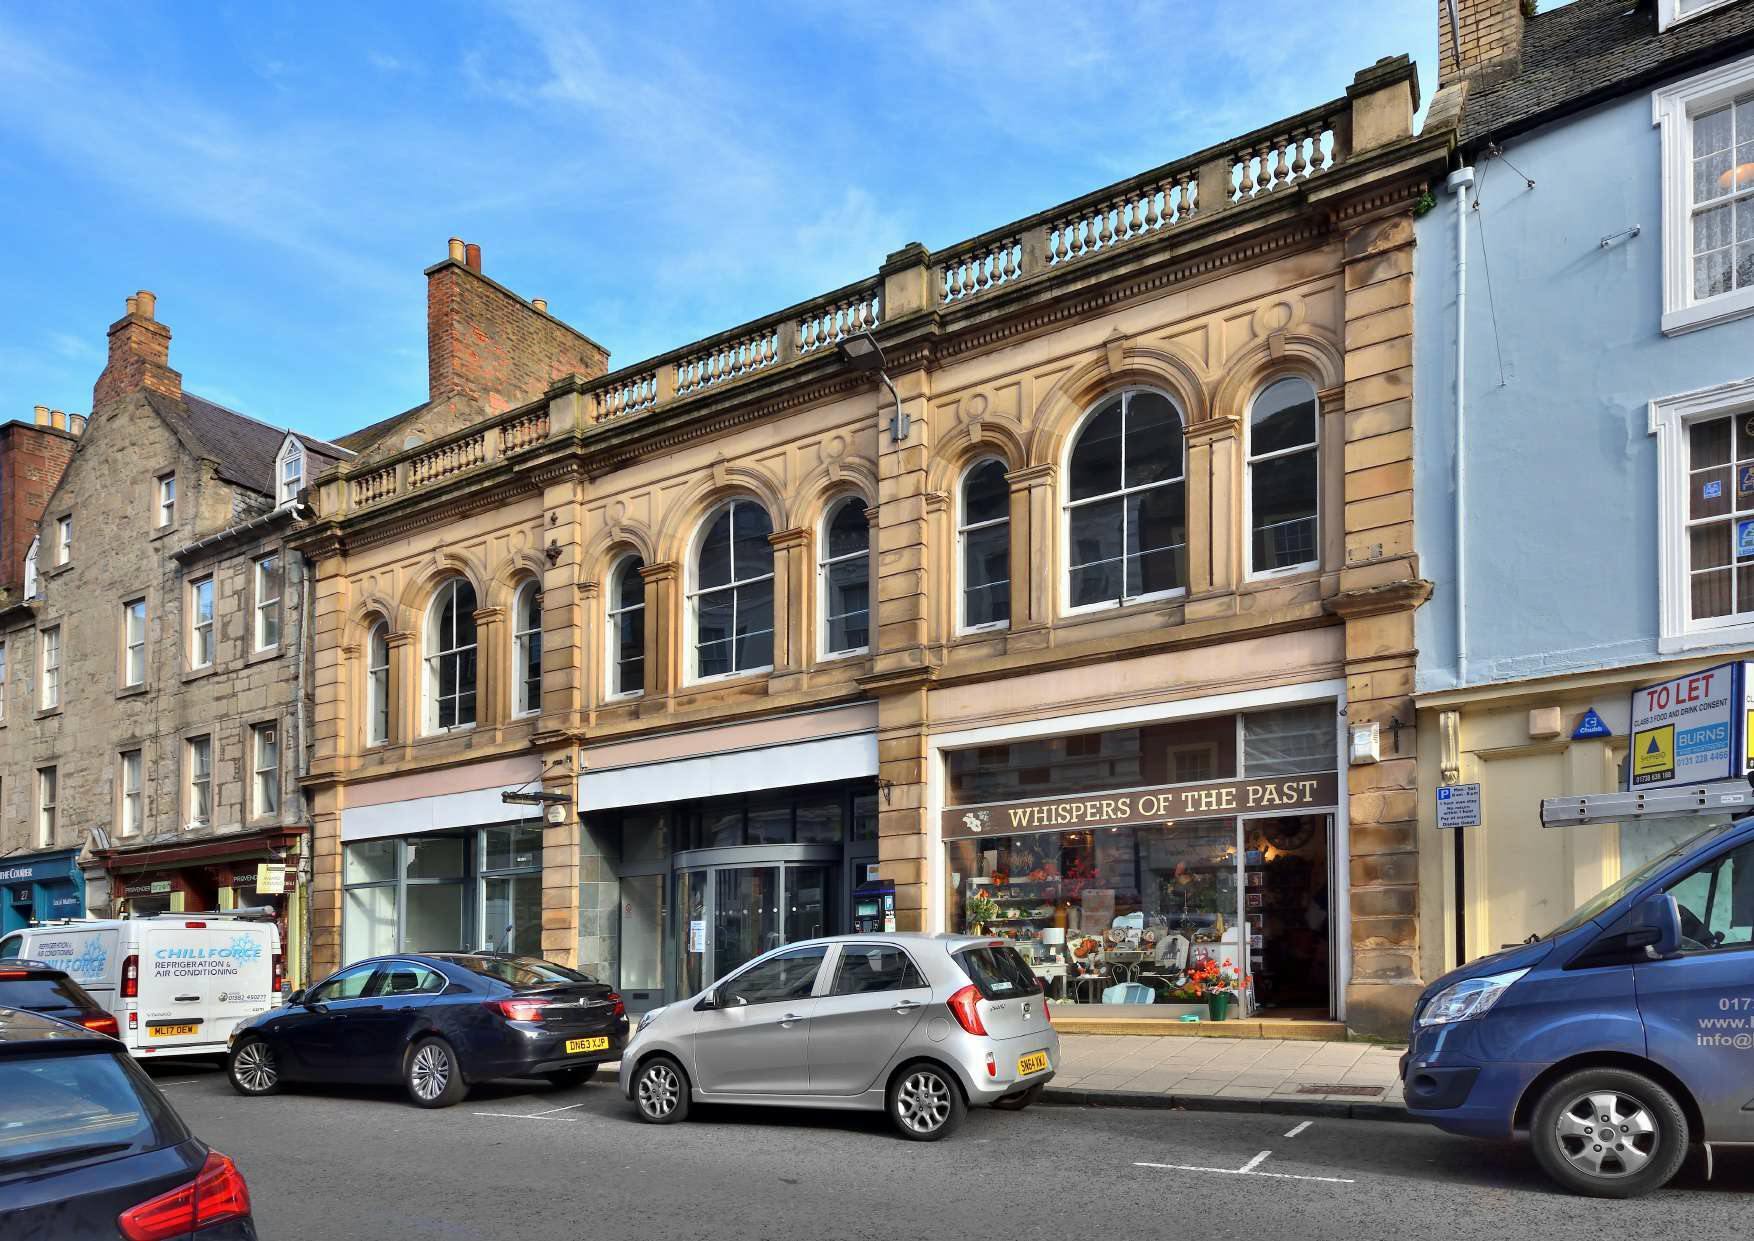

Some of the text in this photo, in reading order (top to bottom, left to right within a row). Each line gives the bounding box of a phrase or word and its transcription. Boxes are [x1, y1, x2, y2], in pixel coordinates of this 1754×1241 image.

[1647, 674, 1714, 712] TO LET
[1634, 716, 1649, 728] CLASS
[1654, 712, 1668, 722] FOOD
[1668, 709, 1680, 719] AND
[1680, 705, 1699, 716] DRINK
[1699, 698, 1728, 712] CONSENT
[1580, 726, 1603, 734] Chubb
[1680, 727, 1725, 745] BURNS
[1441, 790, 1449, 799] P
[1008, 780, 1318, 828] WHISPERS OF THE PAST
[21, 890, 28, 900] 27
[154, 960, 224, 969] REFRIGERATION
[154, 968, 238, 977] AIR CONDITIONING
[1719, 998, 1754, 1011] 017
[1699, 1016, 1754, 1028] www.
[570, 1039, 591, 1051] DN63
[1697, 1033, 1754, 1049] info@
